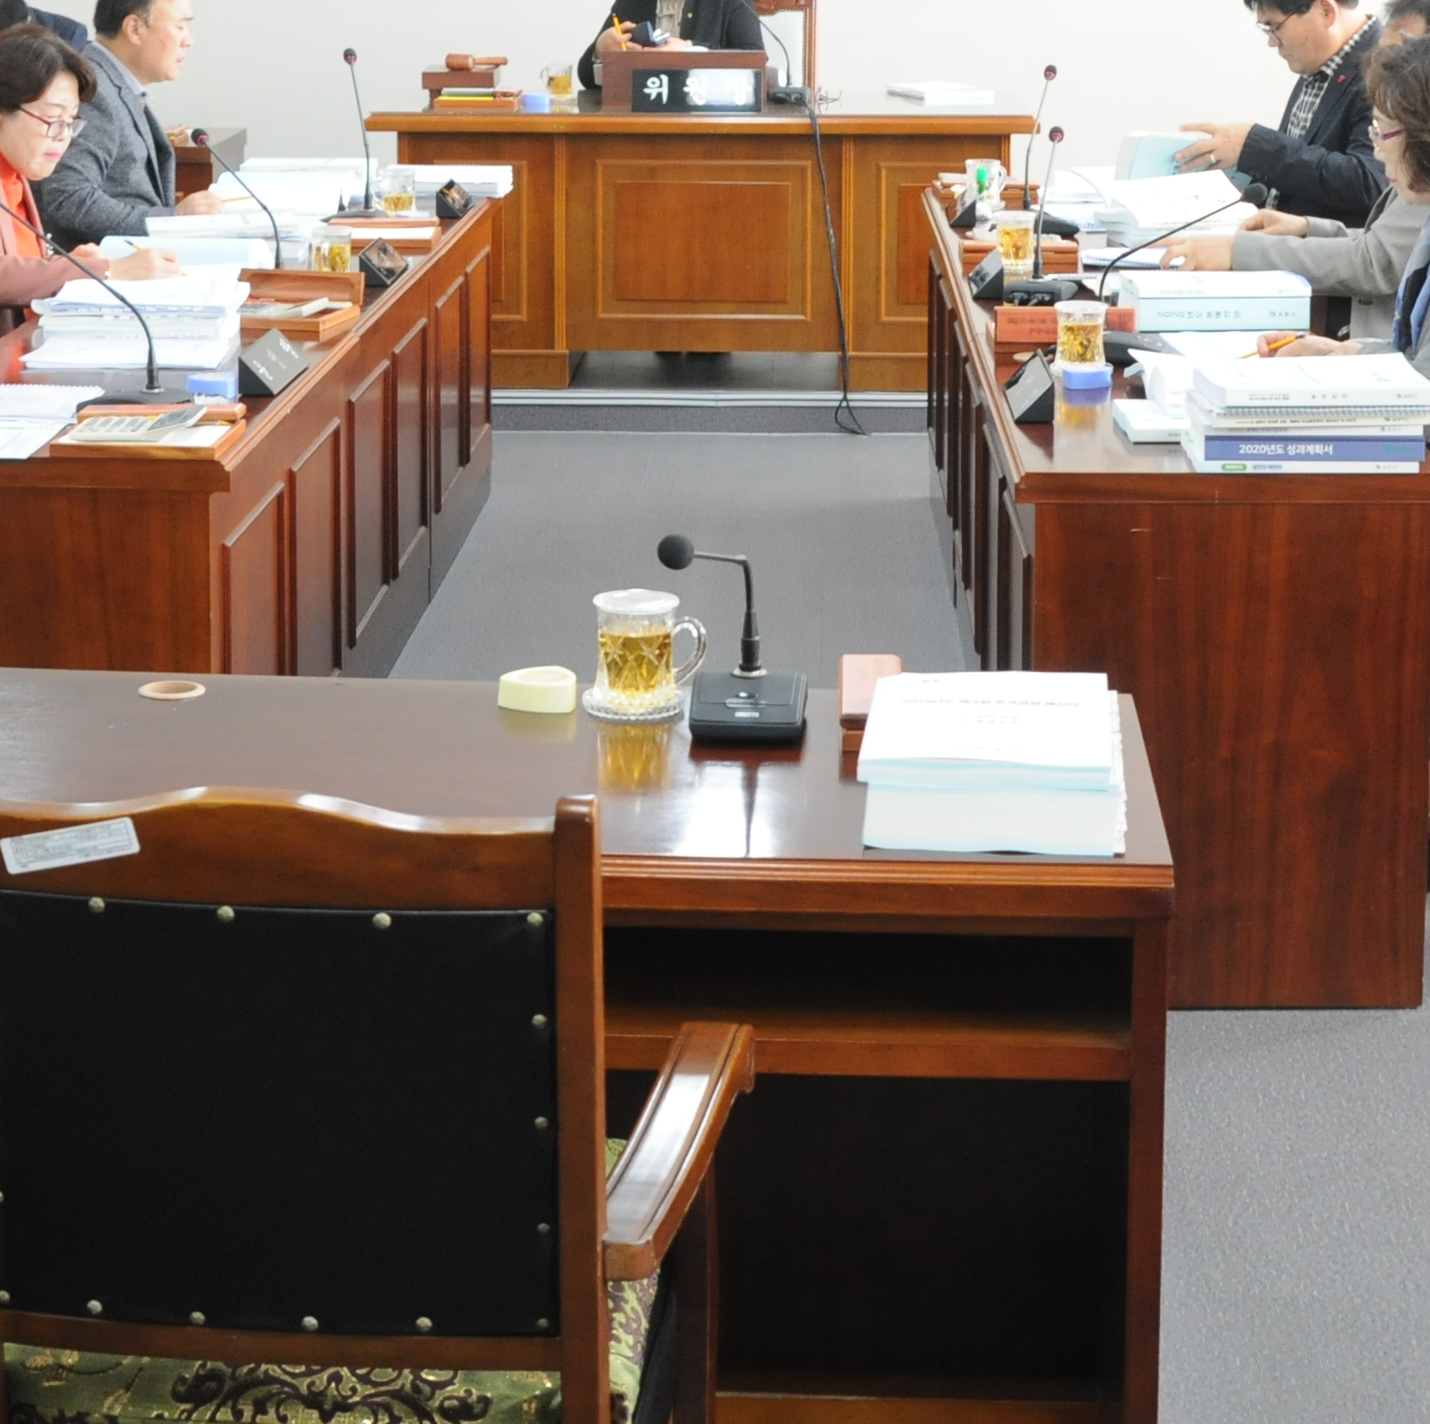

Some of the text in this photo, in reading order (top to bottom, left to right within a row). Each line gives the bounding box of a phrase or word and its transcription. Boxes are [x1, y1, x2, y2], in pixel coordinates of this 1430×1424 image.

[643, 74, 753, 105] 위원장
[1238, 444, 1333, 456] 2020년도 성과계획서
